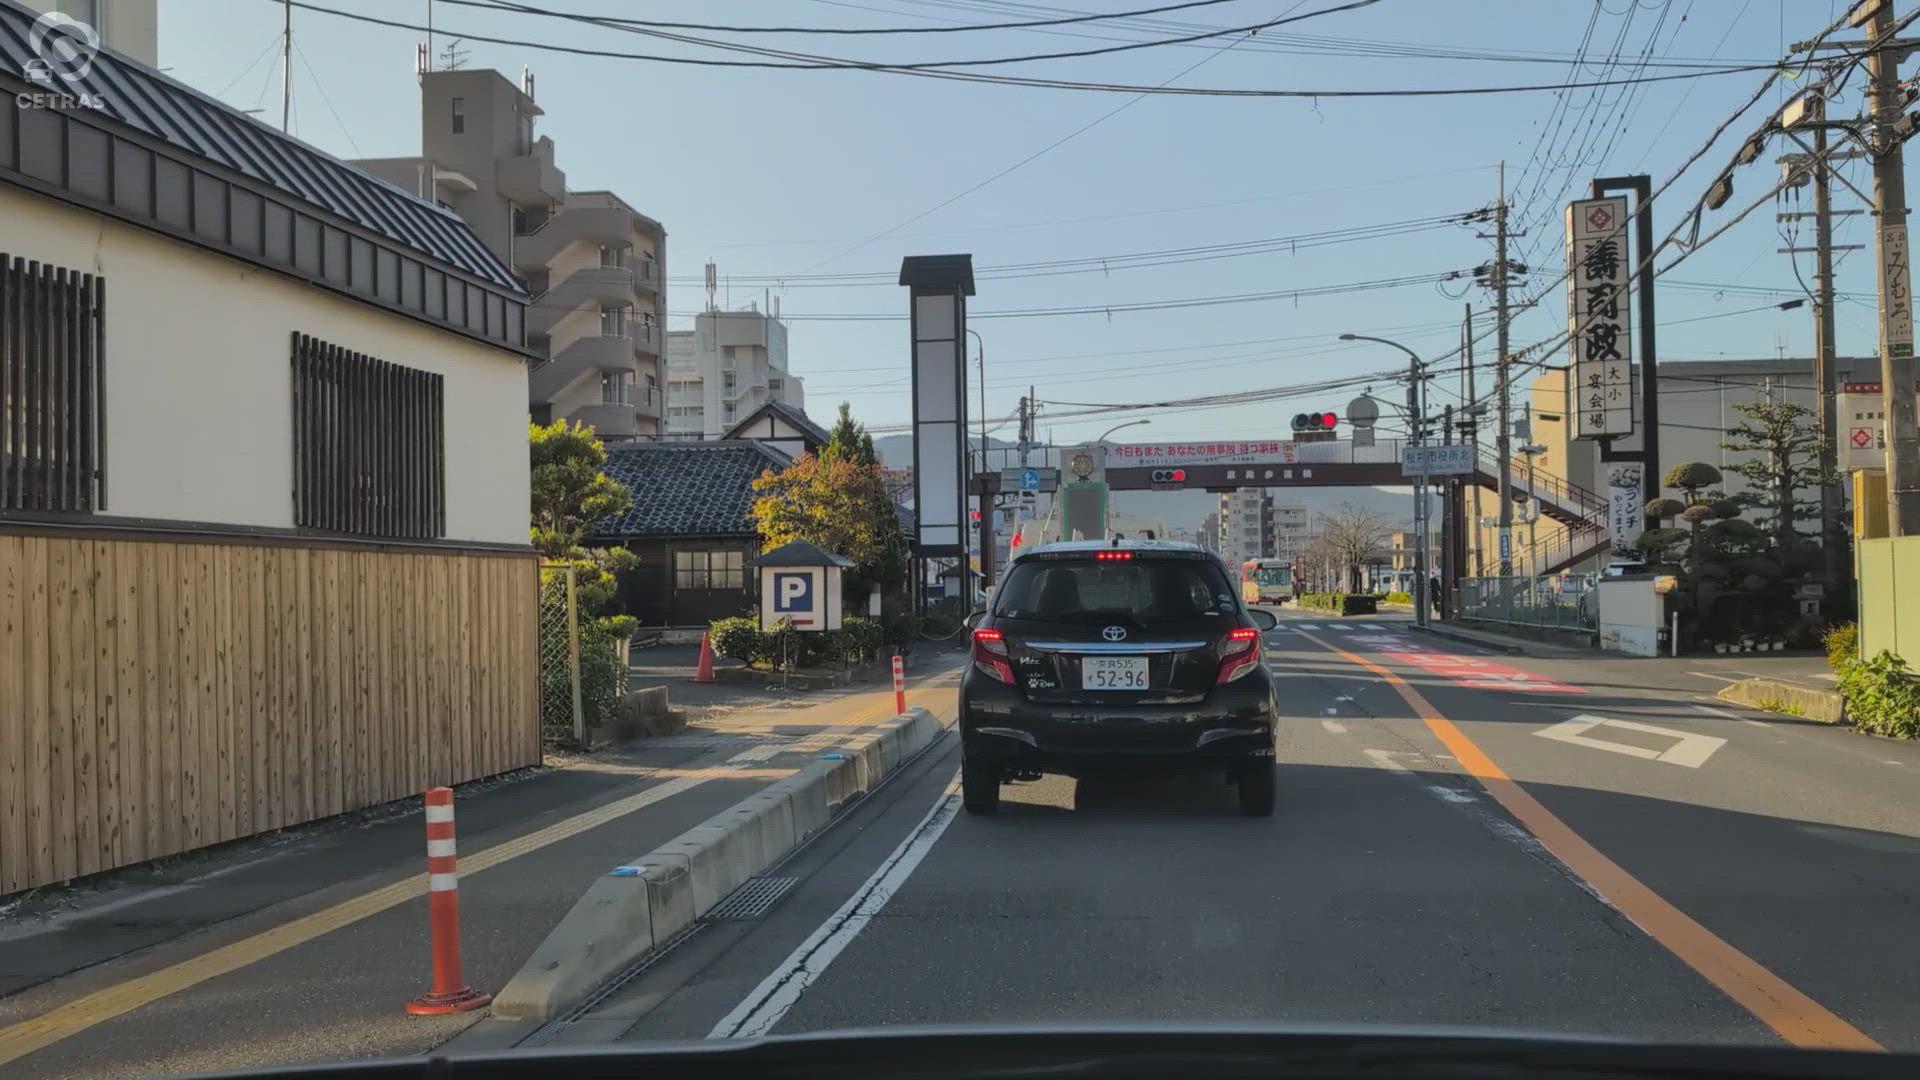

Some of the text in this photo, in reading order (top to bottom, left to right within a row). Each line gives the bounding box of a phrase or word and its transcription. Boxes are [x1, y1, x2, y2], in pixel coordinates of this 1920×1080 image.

[1588, 374, 1604, 429] 宴会場
[781, 576, 807, 609] P
[1096, 670, 1145, 687] 52-96
